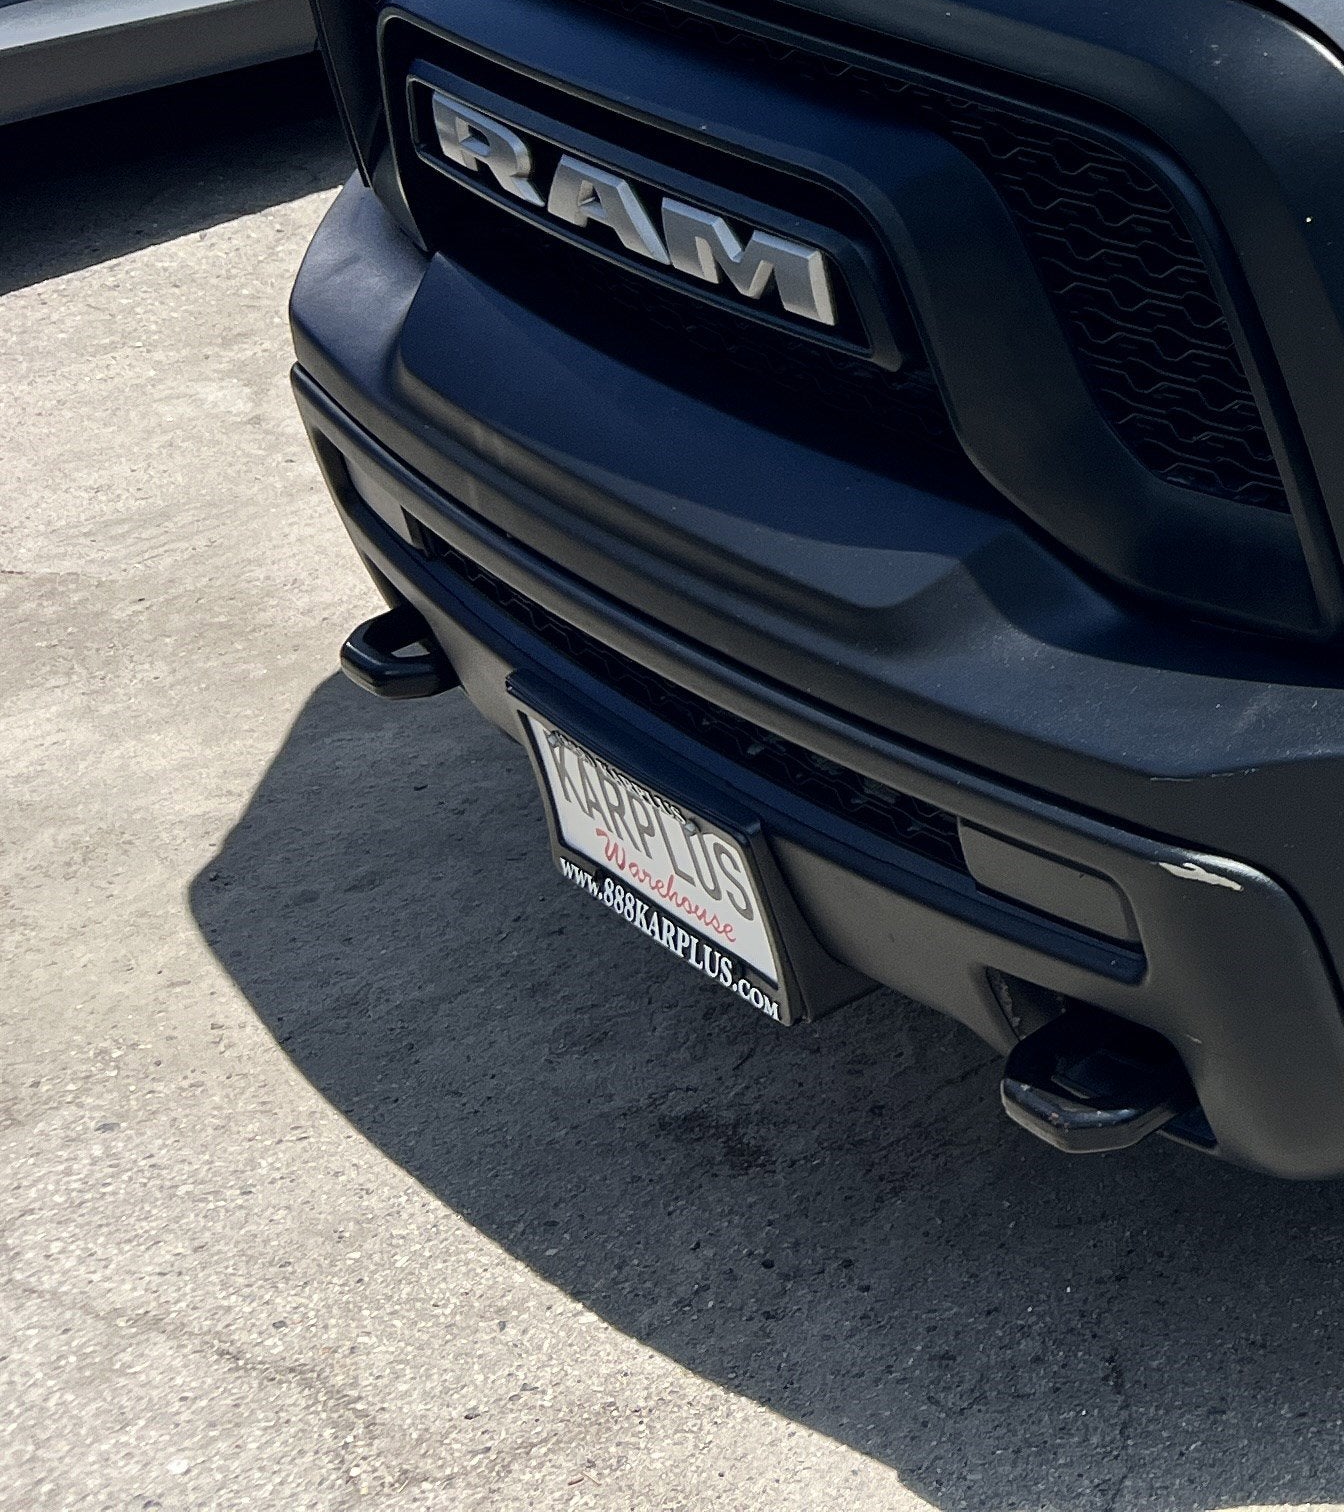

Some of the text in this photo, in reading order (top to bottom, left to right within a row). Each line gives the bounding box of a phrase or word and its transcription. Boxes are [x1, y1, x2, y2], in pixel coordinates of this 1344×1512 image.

[431, 91, 837, 327] RAM
[543, 728, 755, 922] KARPLUS
[595, 827, 738, 944] Warehouse
